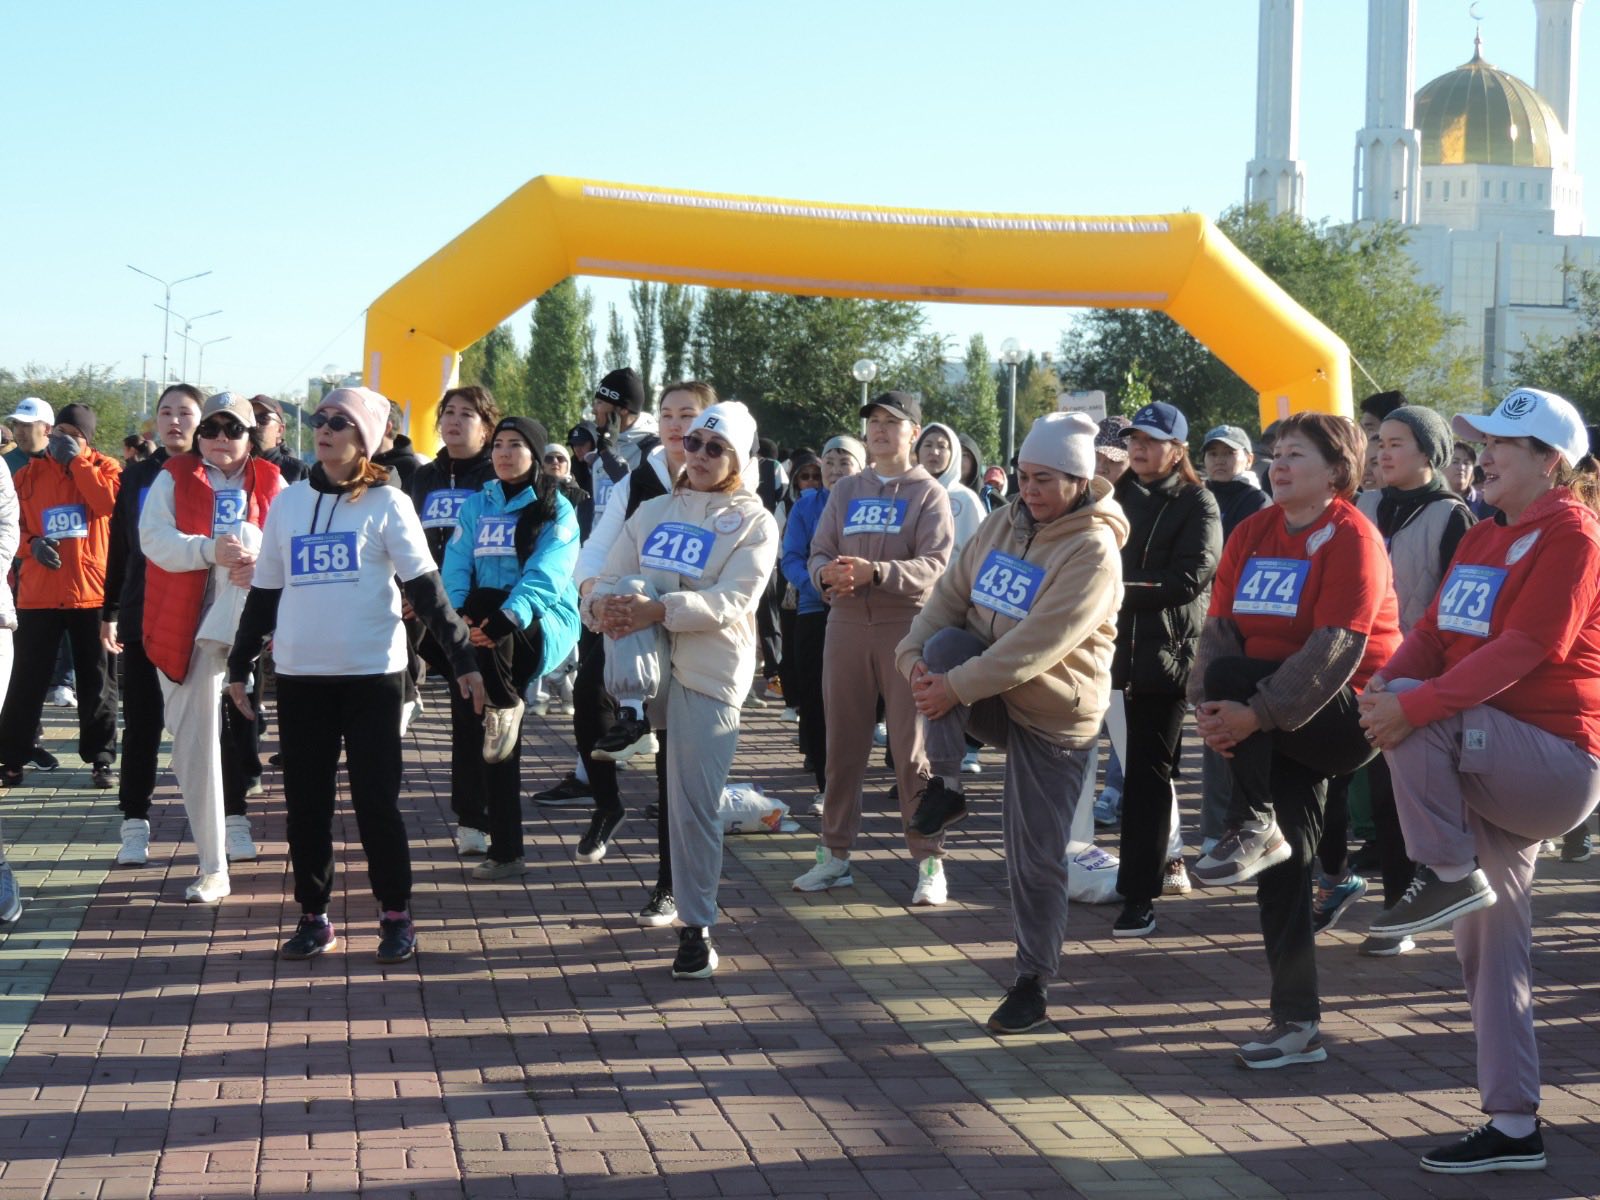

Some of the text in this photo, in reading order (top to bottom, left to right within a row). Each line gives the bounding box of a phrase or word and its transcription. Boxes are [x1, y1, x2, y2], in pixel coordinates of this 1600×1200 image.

[47, 512, 82, 532] 490
[427, 497, 465, 518] 437
[850, 505, 897, 524] 483
[478, 524, 516, 546] 441
[647, 531, 703, 564] 218
[297, 543, 350, 572] 158
[979, 564, 1032, 605] 435
[1242, 570, 1297, 602] 474
[1441, 579, 1491, 618] 473
